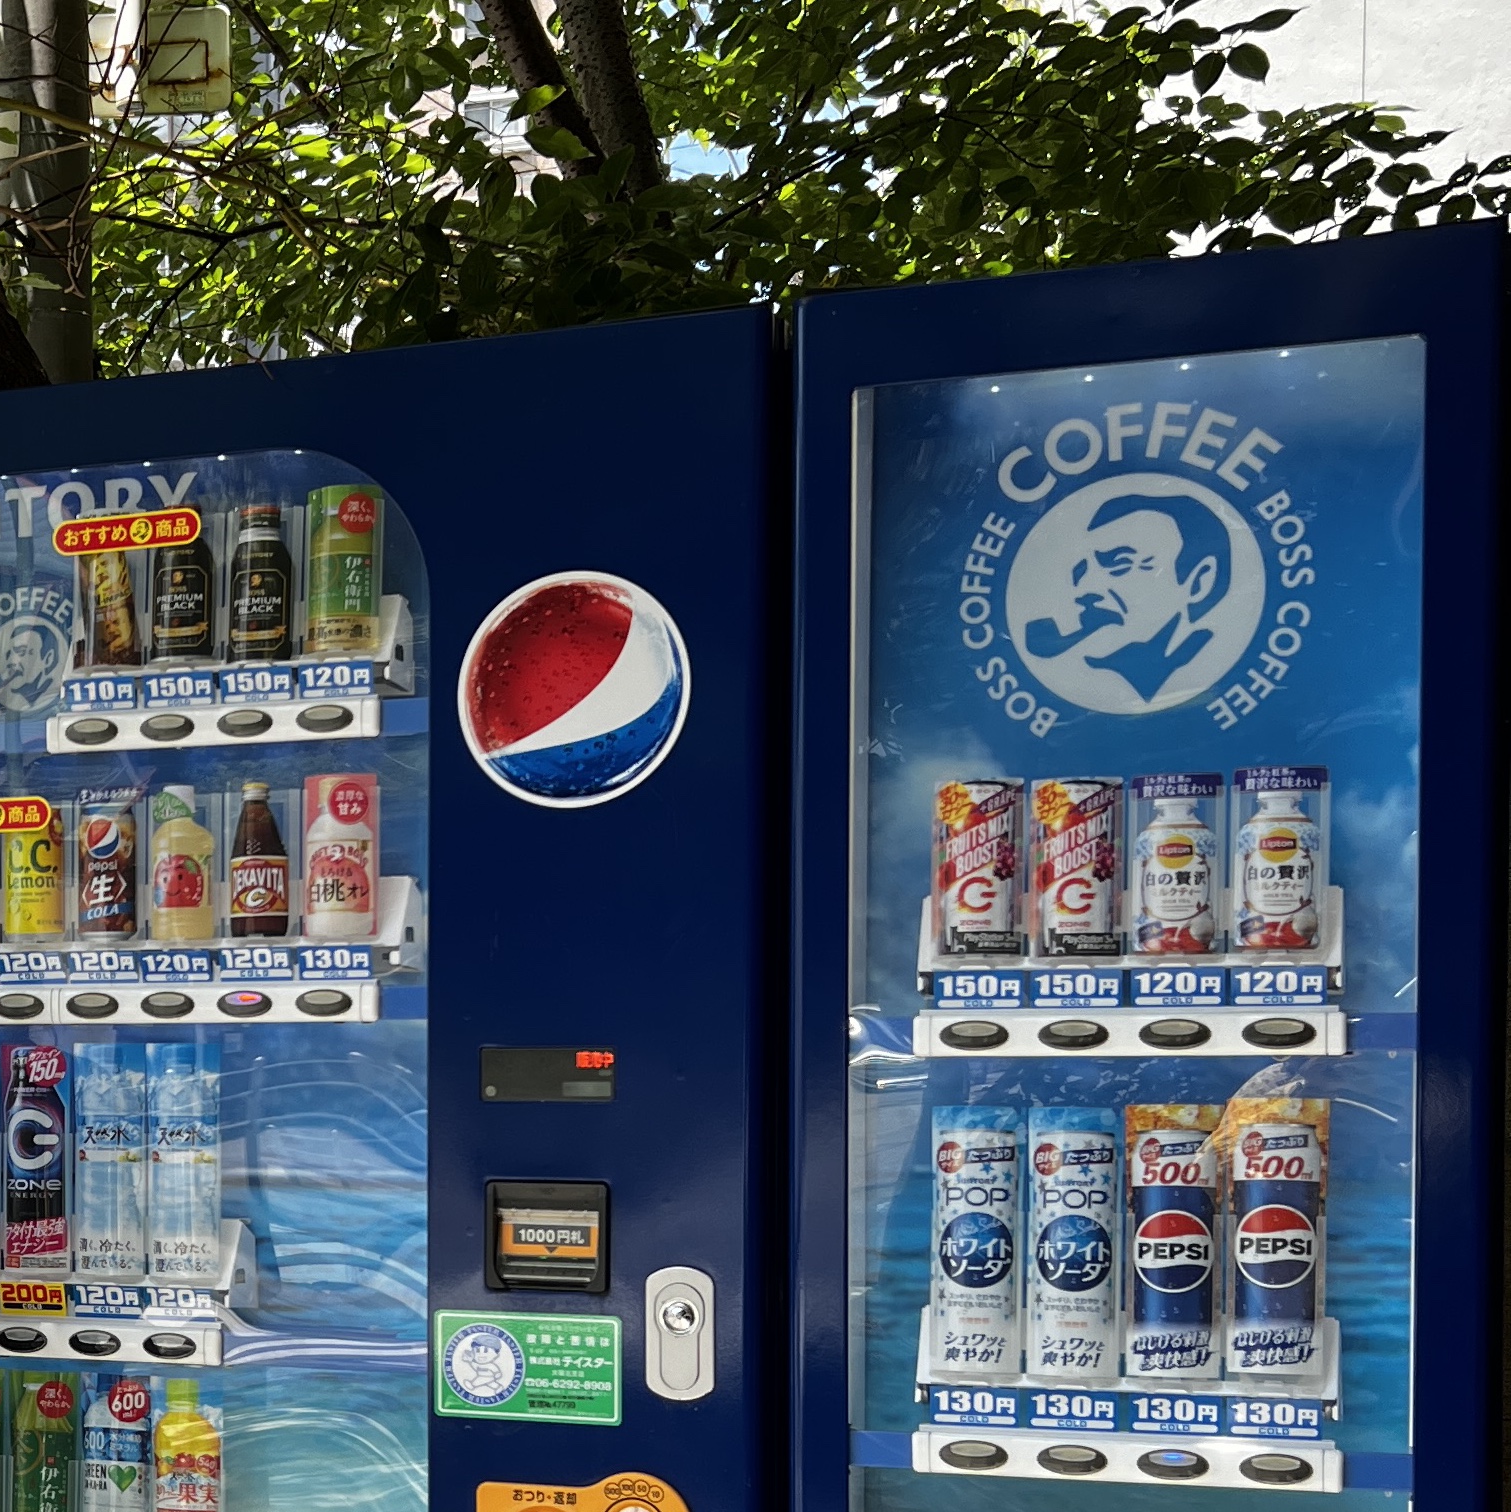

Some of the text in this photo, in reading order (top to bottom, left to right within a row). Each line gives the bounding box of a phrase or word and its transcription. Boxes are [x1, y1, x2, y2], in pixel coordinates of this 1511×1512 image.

[998, 401, 1284, 502] COFFEE
[64, 517, 190, 547] おすすめ 商品
[959, 511, 1016, 650] COFFEE
[156, 593, 204, 605] PREMIUM
[161, 602, 196, 612] BLACK
[233, 597, 282, 608] PREMIUM
[238, 604, 275, 615] BLACK
[1206, 489, 1315, 731] BOSS COFFEE
[223, 672, 290, 692] 150円
[301, 666, 370, 686] 120円
[69, 680, 133, 702] 110円
[146, 677, 211, 697] 150円
[975, 656, 1059, 738] BOSS
[8, 804, 40, 823] 商品
[337, 802, 362, 816] 甘み
[946, 812, 1010, 862] FRUITS MIX
[1044, 811, 1110, 862] FRUITS MIX
[1262, 839, 1295, 849] Lipton
[8, 839, 58, 873] C.C.
[956, 837, 1001, 878] BOOST
[1054, 837, 1100, 879] BOOST
[1159, 846, 1192, 856] Lipton
[1145, 871, 1208, 887] 白の贅沢
[1247, 864, 1311, 881] 白の贅沢
[87, 903, 120, 921] COLA
[0, 953, 62, 972] 120円
[70, 952, 135, 971] 120円
[142, 954, 208, 972] 120円
[222, 948, 289, 969] 120円
[300, 950, 370, 968] 130円
[938, 975, 1020, 997] 150円
[1035, 974, 1119, 996] 150円
[1134, 973, 1222, 994] 120円
[1235, 971, 1323, 994] 120円
[84, 1126, 132, 1145] 天然水
[158, 1127, 206, 1146] 天然水
[1265, 1136, 1305, 1149] たっぷり
[938, 1150, 962, 1162] BIG
[967, 1150, 1012, 1162] たっぷり
[1036, 1151, 1060, 1163] BIG
[1064, 1151, 1110, 1163] たっぷり
[945, 1187, 1010, 1206] POP
[1043, 1189, 1109, 1209] POP
[518, 1227, 585, 1245] 1000円札
[940, 1237, 1013, 1259] ホワイト
[1038, 1240, 1111, 1262] ホワイト
[1137, 1241, 1209, 1261] PEPSI
[1238, 1236, 1313, 1257] PEPSI
[949, 1257, 1012, 1279] ソーダ
[1046, 1261, 1110, 1283] ソーダ
[0, 1284, 63, 1304] 200円
[75, 1285, 139, 1306] 120円
[146, 1288, 212, 1309] 120円
[944, 1332, 1008, 1347] シュワッと
[1041, 1335, 1106, 1350] シュワッと
[943, 1347, 1003, 1364] 爽やか!
[1041, 1352, 1101, 1368] 爽やか!
[111, 1391, 145, 1412] 600
[934, 1390, 1016, 1414] 130円
[1031, 1394, 1113, 1418] 130円
[1133, 1397, 1218, 1423] 130円
[1232, 1401, 1318, 1426] 130円
